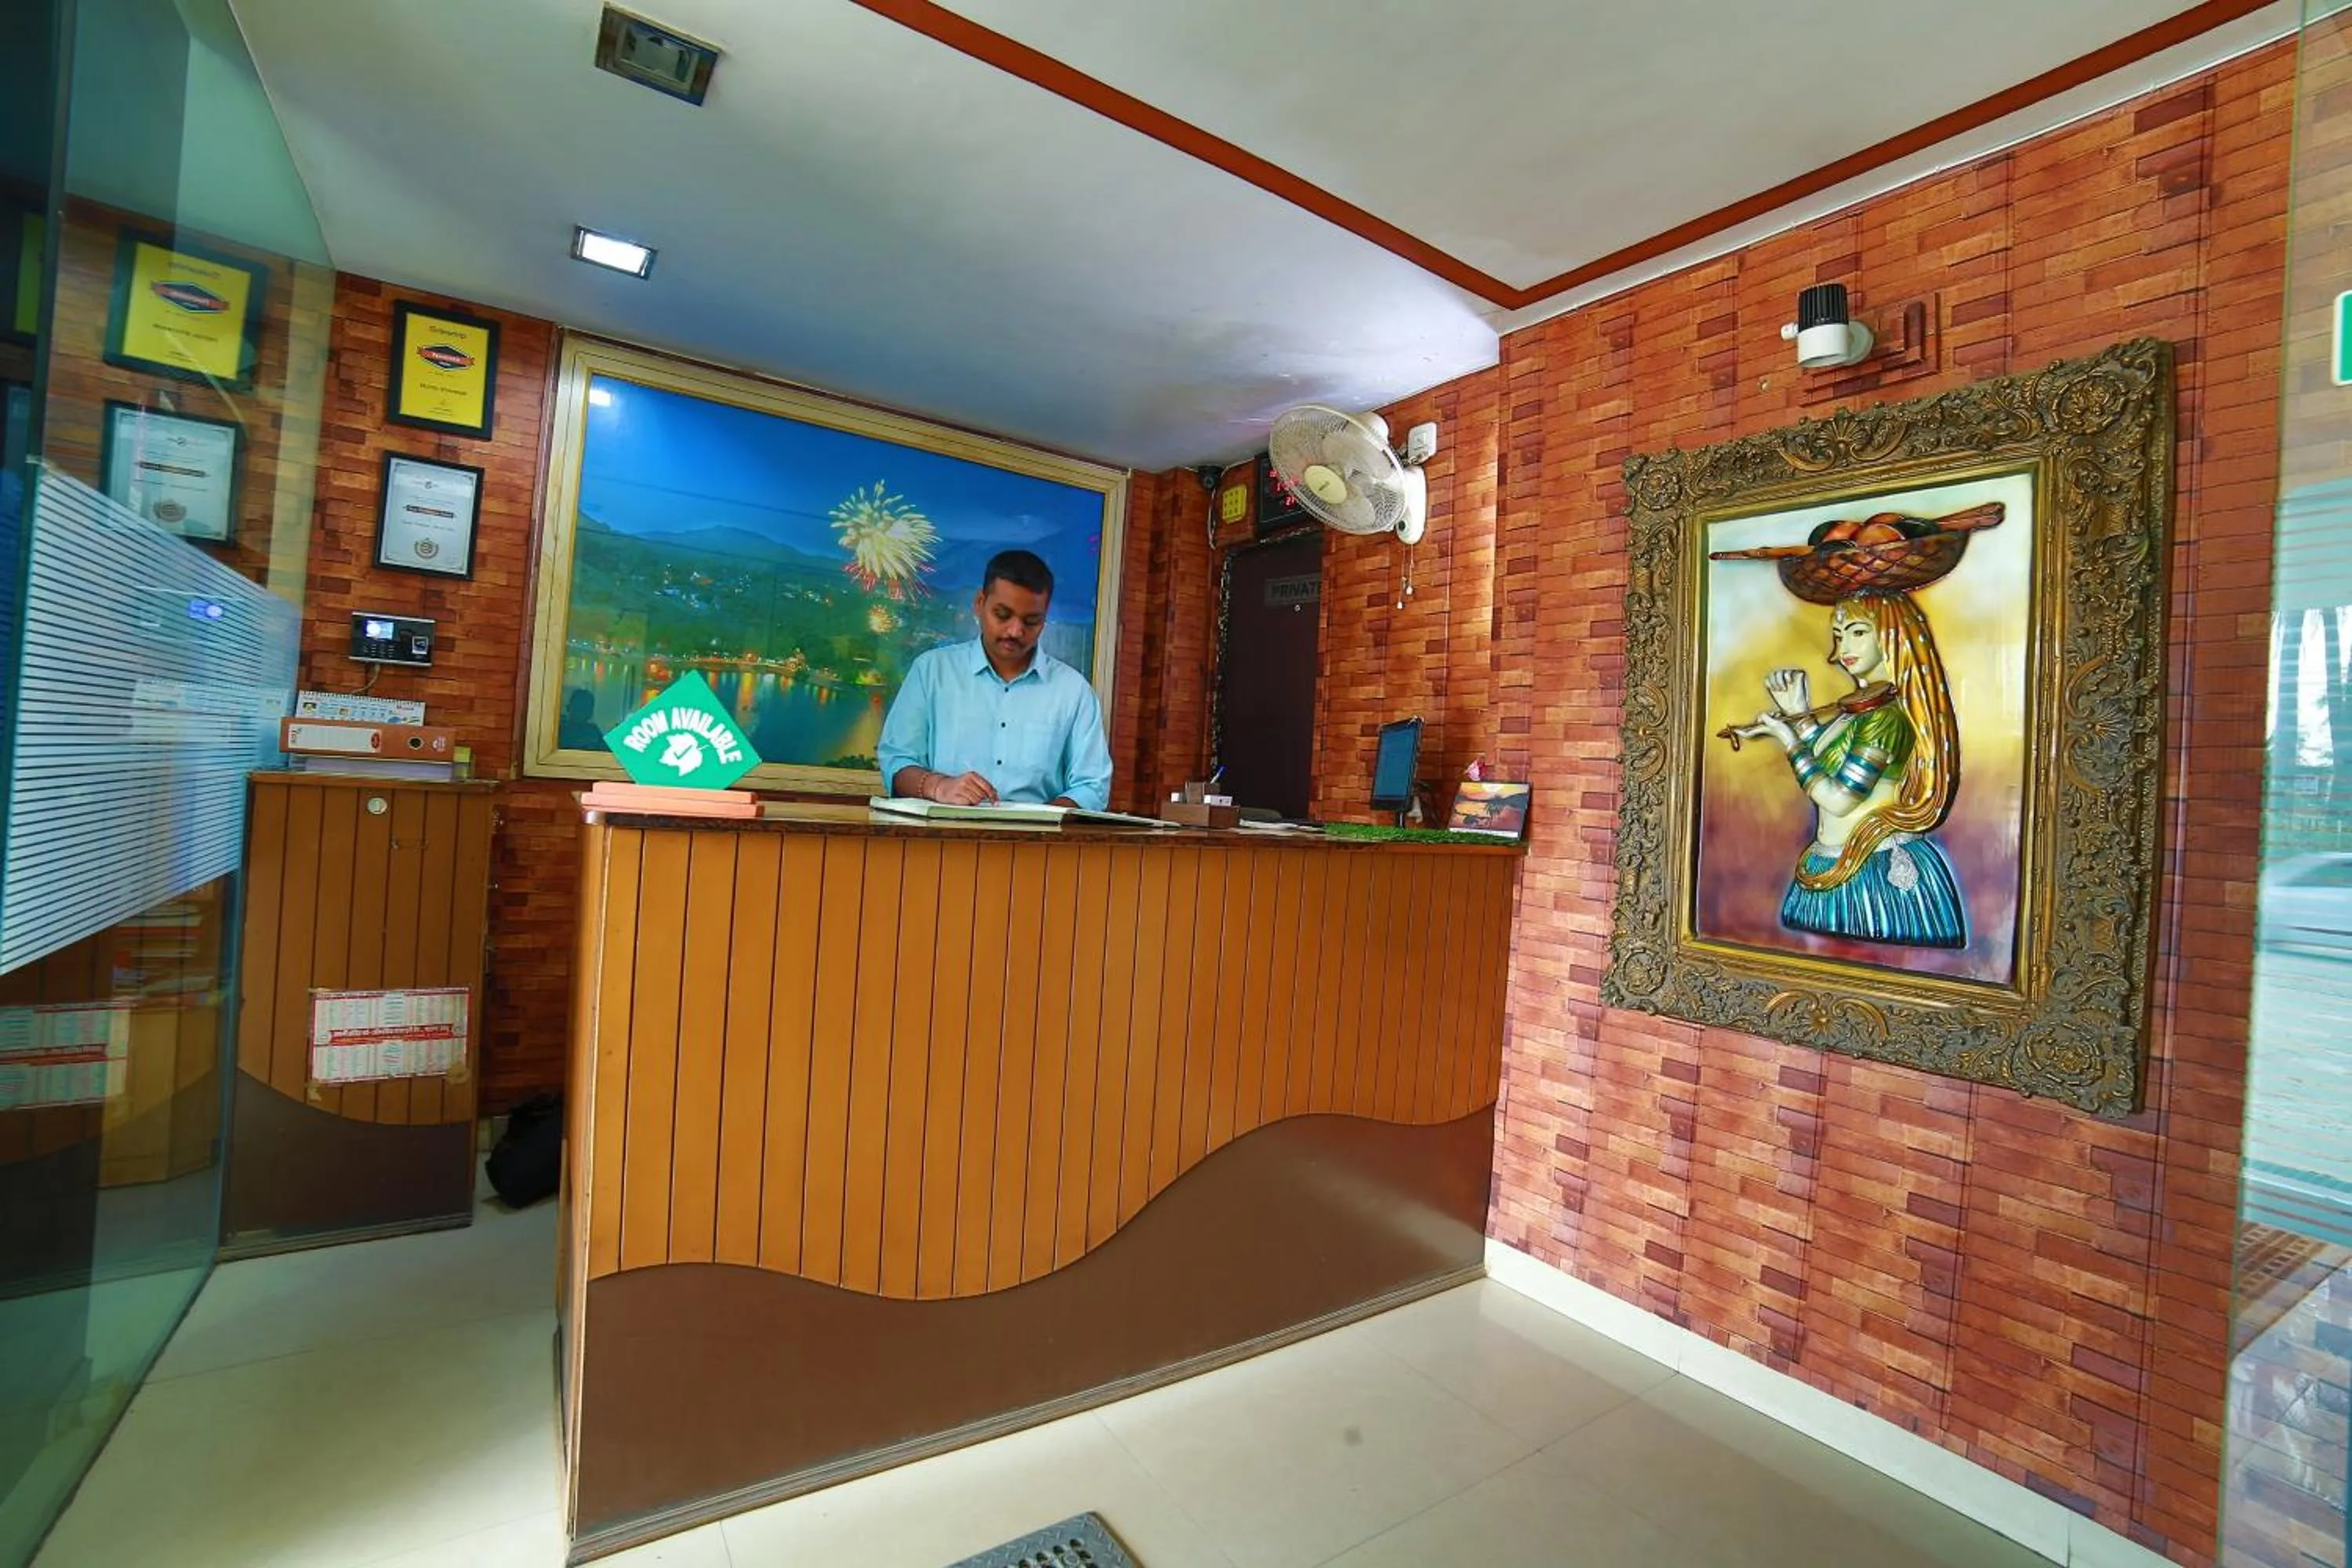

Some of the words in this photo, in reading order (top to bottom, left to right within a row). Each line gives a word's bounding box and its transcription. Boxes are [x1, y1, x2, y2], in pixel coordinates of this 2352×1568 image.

[1272, 581, 1319, 598] PRIVAT
[623, 710, 669, 753] ROOM
[671, 706, 743, 764] AVAILABLE
